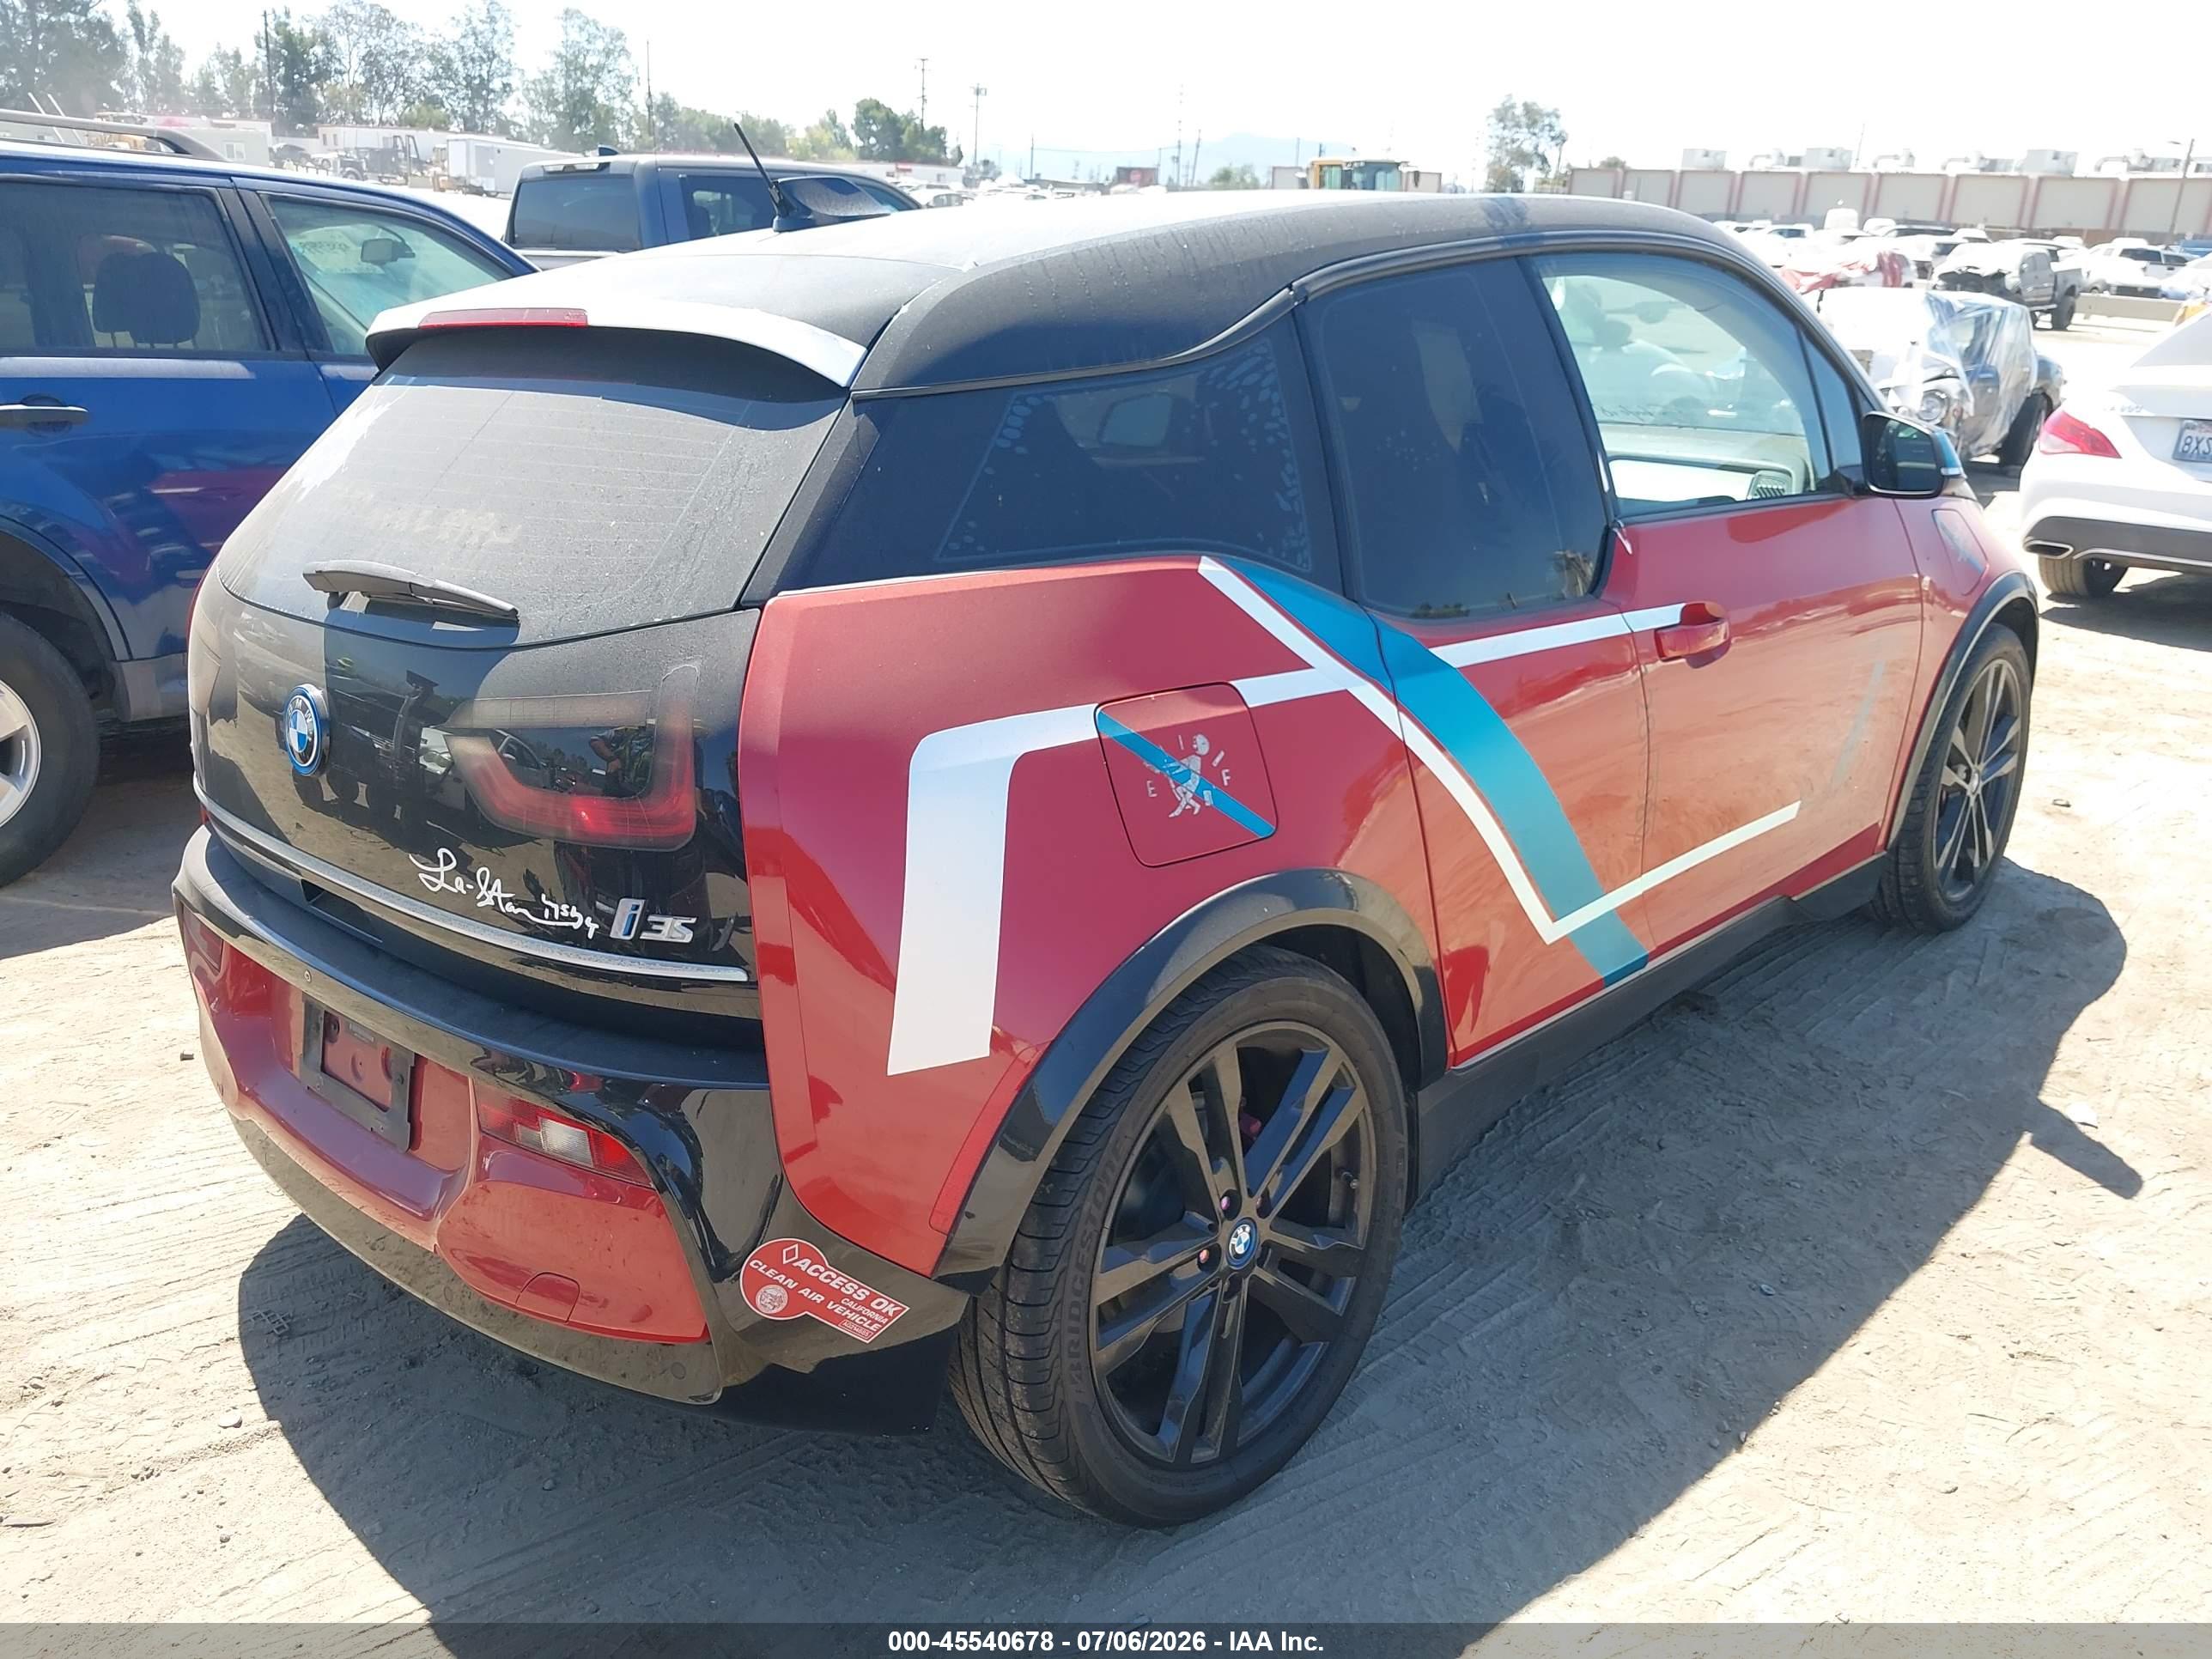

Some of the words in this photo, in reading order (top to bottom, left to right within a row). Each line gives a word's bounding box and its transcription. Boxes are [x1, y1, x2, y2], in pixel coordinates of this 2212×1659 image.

[749, 1259, 799, 1289] CLEAN
[798, 1287, 825, 1304] AIR
[826, 1300, 883, 1332] VEHICLE
[793, 1258, 870, 1301] ACCESS
[870, 1297, 902, 1317] OK
[1067, 1138, 1128, 1388] BRIDGESTONE
[841, 1297, 888, 1324] CALIFORNIA
